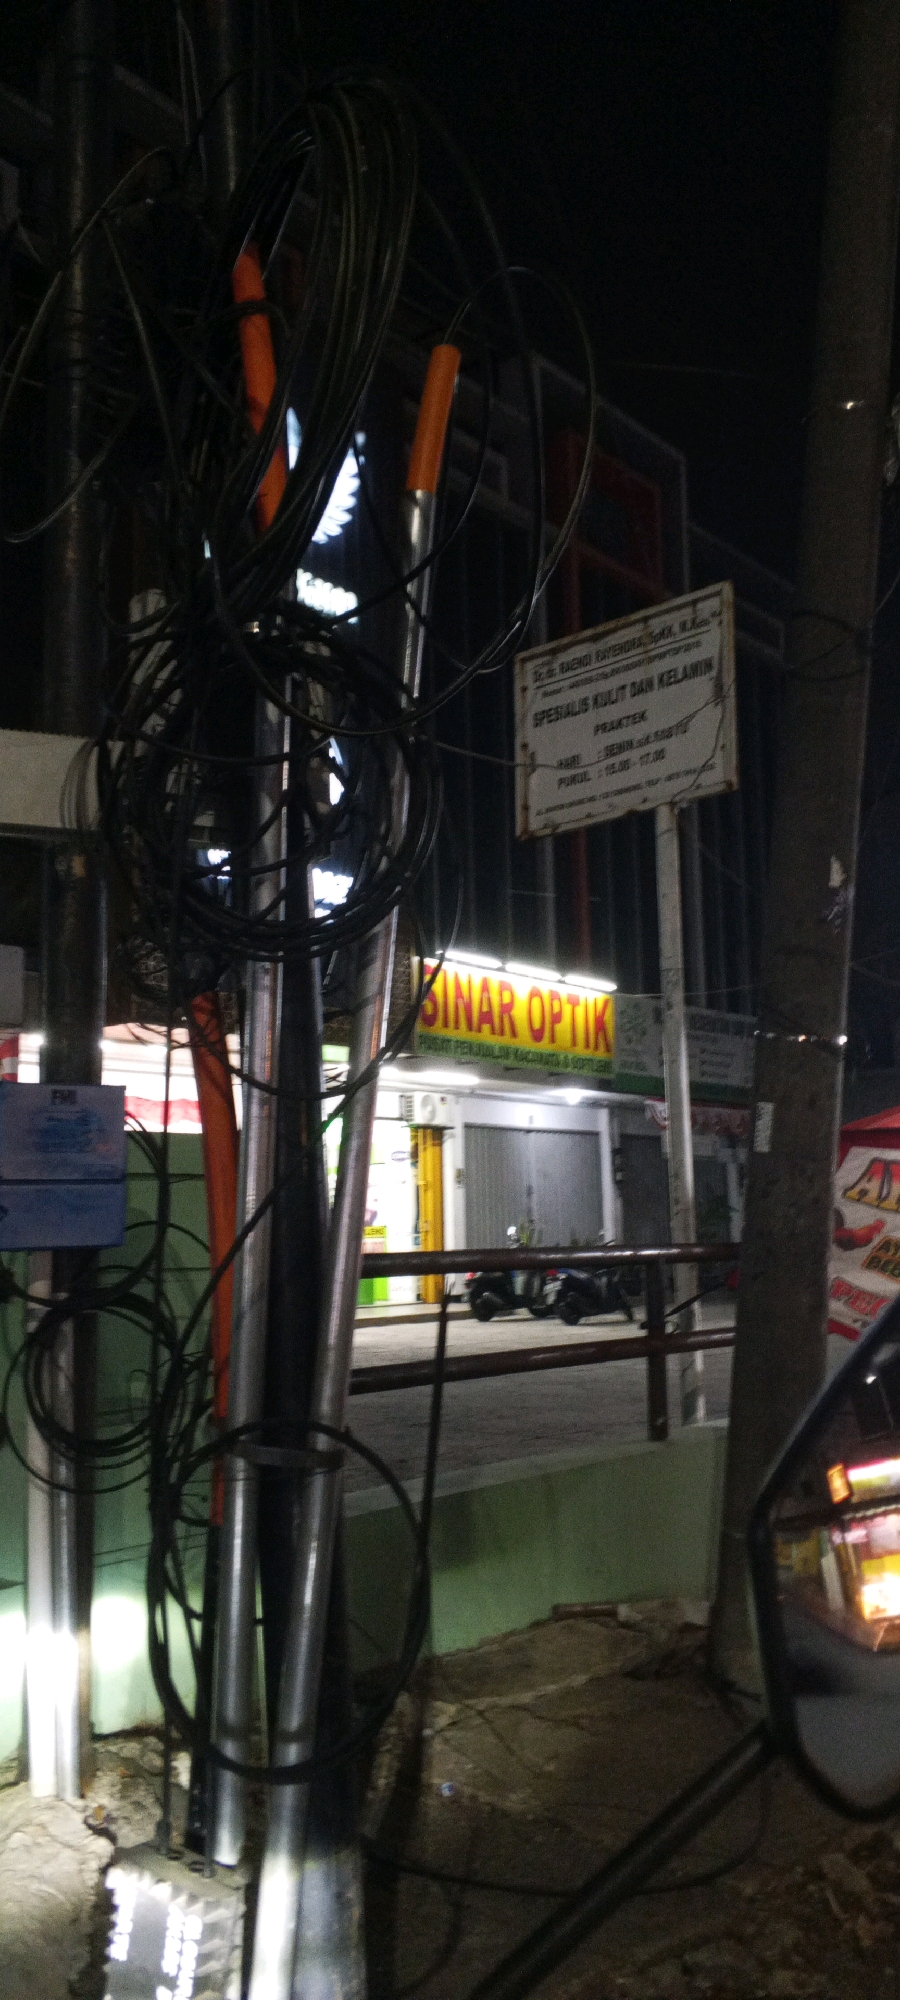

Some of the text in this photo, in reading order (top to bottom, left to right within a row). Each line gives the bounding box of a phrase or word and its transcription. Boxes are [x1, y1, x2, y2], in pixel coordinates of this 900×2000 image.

[533, 696, 589, 728] SPESIALIS
[592, 684, 626, 710] KULIT
[630, 675, 654, 697] DAN
[657, 656, 713, 689] KELAMIN
[594, 709, 647, 736] PRAKTEK
[557, 753, 580, 770] HARI
[603, 738, 633, 758] SENIN
[557, 769, 590, 789] PUKUL
[420, 962, 518, 1039] SINAR
[527, 985, 614, 1053] OPTIK
